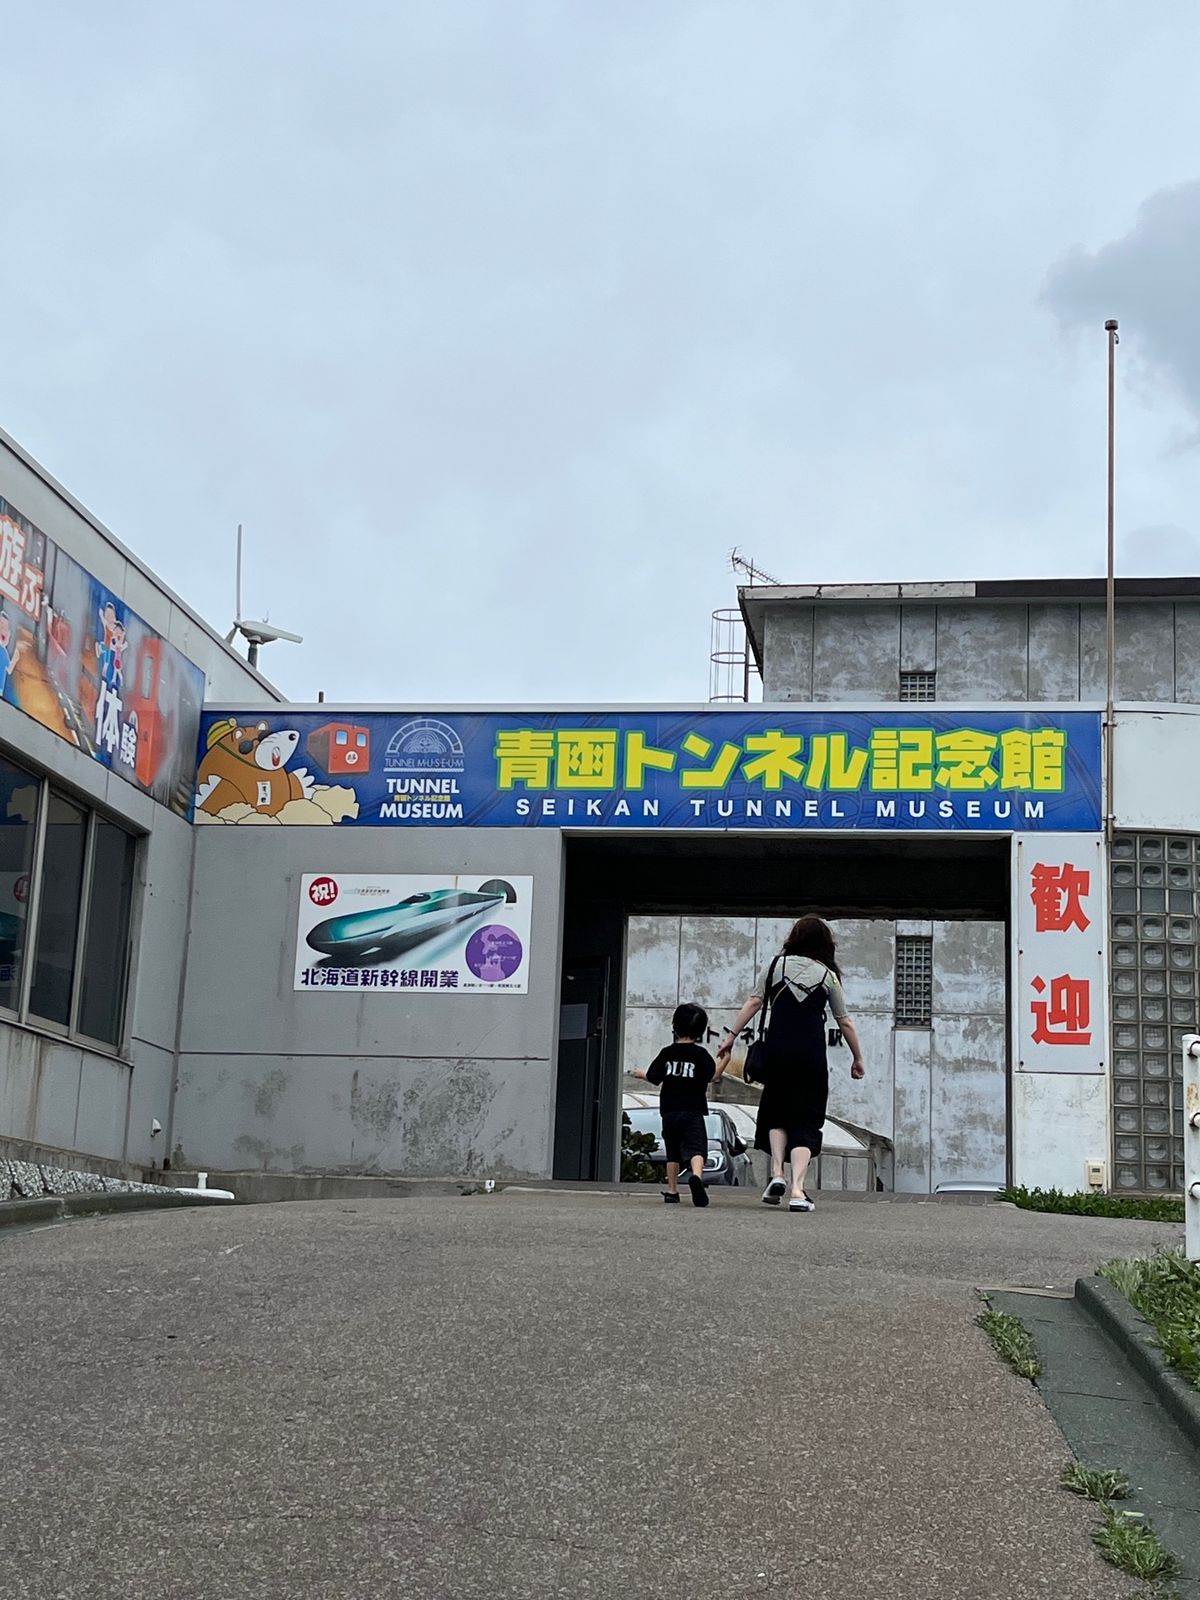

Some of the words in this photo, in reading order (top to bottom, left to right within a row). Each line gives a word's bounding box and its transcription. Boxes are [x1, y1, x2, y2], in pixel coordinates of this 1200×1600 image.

[95, 680, 138, 769] 体験
[495, 728, 1066, 792] 青函トンネル記念館
[386, 778, 460, 794] TUNNEL
[379, 803, 464, 819] MUSEUM
[516, 799, 661, 818] SEIKAN
[690, 799, 846, 818] TUNNEL
[877, 799, 1046, 819] MUSEUM
[1030, 862, 1092, 1046] 歓迎
[301, 967, 460, 988] 北海道新幹線開業
